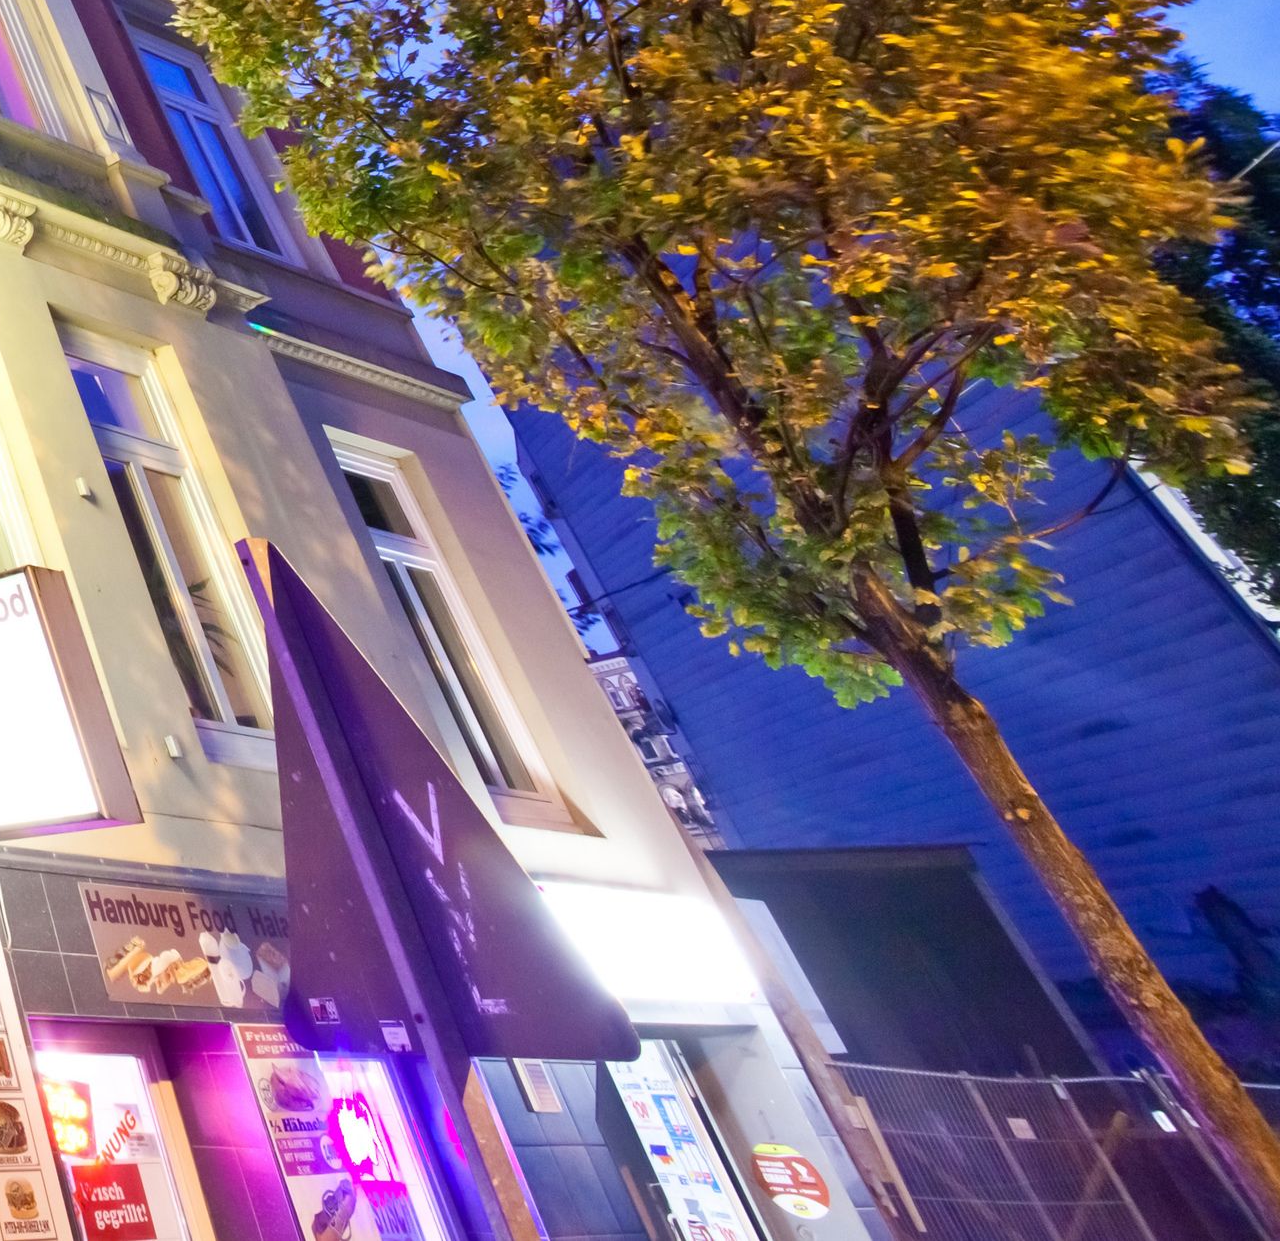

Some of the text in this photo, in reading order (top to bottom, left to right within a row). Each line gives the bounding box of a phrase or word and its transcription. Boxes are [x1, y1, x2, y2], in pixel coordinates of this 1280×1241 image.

[85, 889, 185, 937] Hamburg
[185, 901, 239, 934] Food
[245, 1031, 288, 1042] Frisch
[96, 1110, 136, 1166] NUNG
[95, 1203, 148, 1230] gegrillt!
